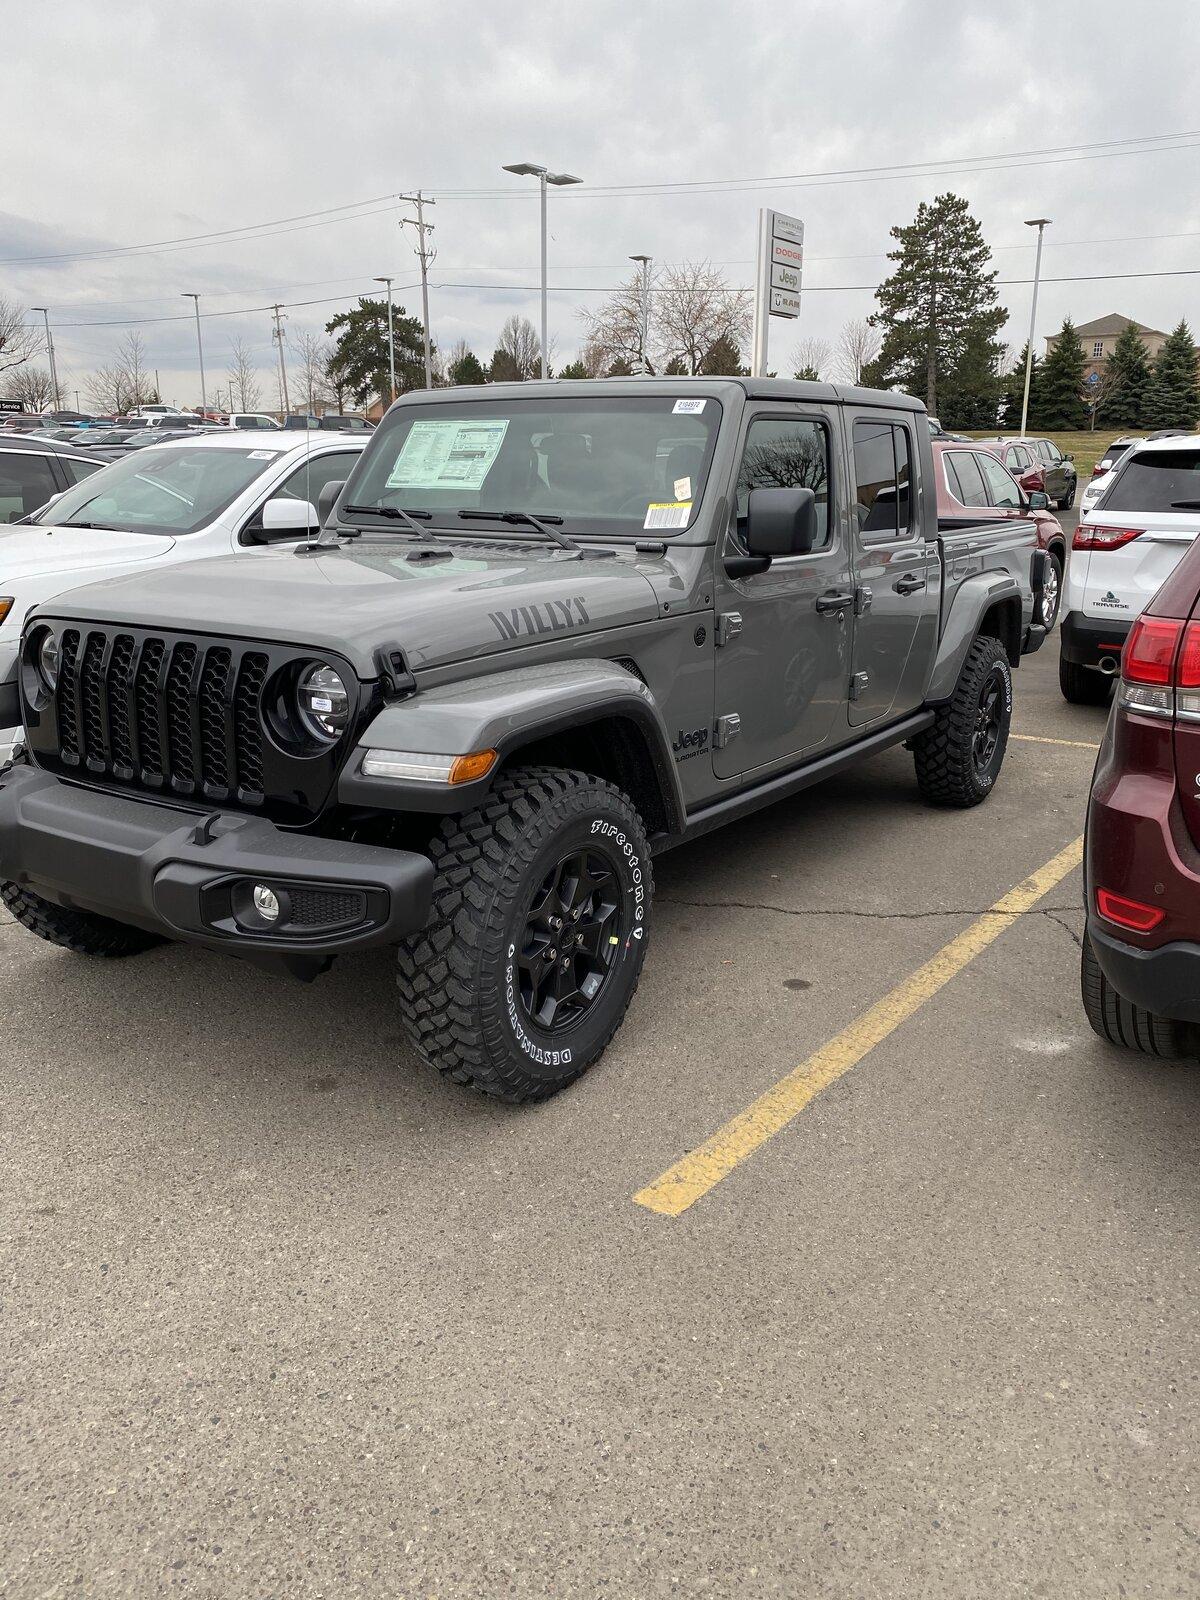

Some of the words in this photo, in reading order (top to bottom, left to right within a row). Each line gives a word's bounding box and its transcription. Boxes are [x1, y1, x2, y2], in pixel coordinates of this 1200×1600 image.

[775, 247, 802, 261] DODGE
[779, 268, 798, 288] Jeep
[782, 298, 800, 308] RAM
[1092, 601, 1130, 609] TRAVERSE
[487, 596, 590, 640] WILLYS
[673, 728, 707, 752] Jeep
[590, 819, 645, 921] Firestone
[505, 965, 572, 1066] DESTINATION
